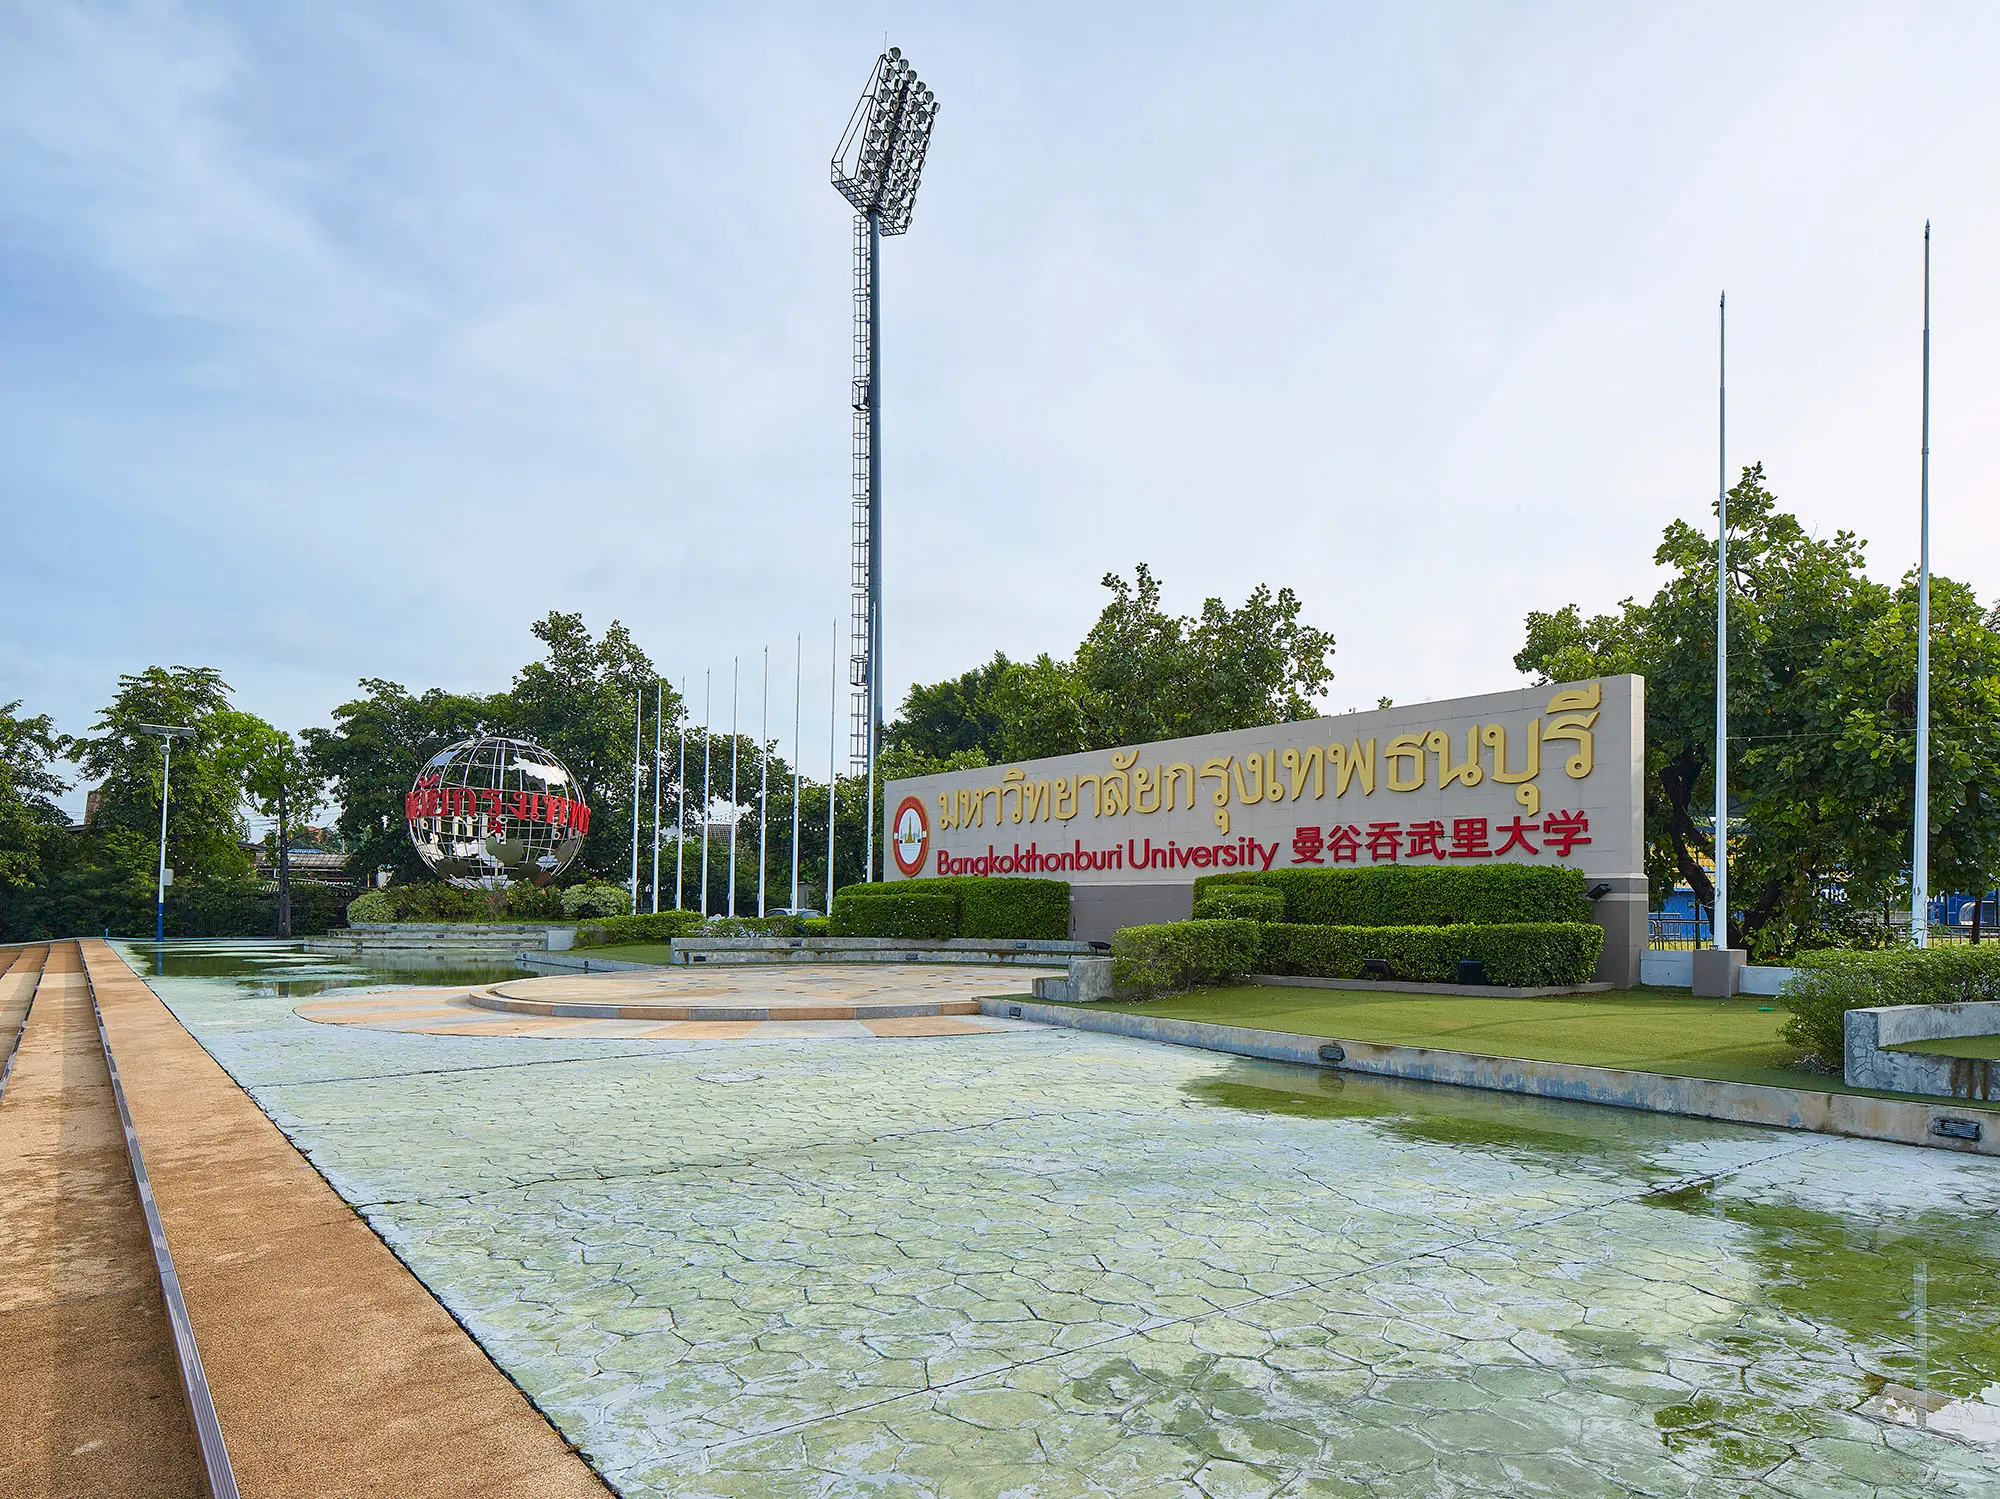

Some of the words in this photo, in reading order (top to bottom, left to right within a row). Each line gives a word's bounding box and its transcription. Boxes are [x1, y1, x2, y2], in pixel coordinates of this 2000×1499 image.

[938, 682, 1602, 834] มหาวิทยาลัยกรุงเทพธนบุรี
[938, 839, 1123, 877] Bangkokthonburi
[1128, 837, 1277, 877] University
[1290, 809, 1592, 864] 曼谷吞武里大学
